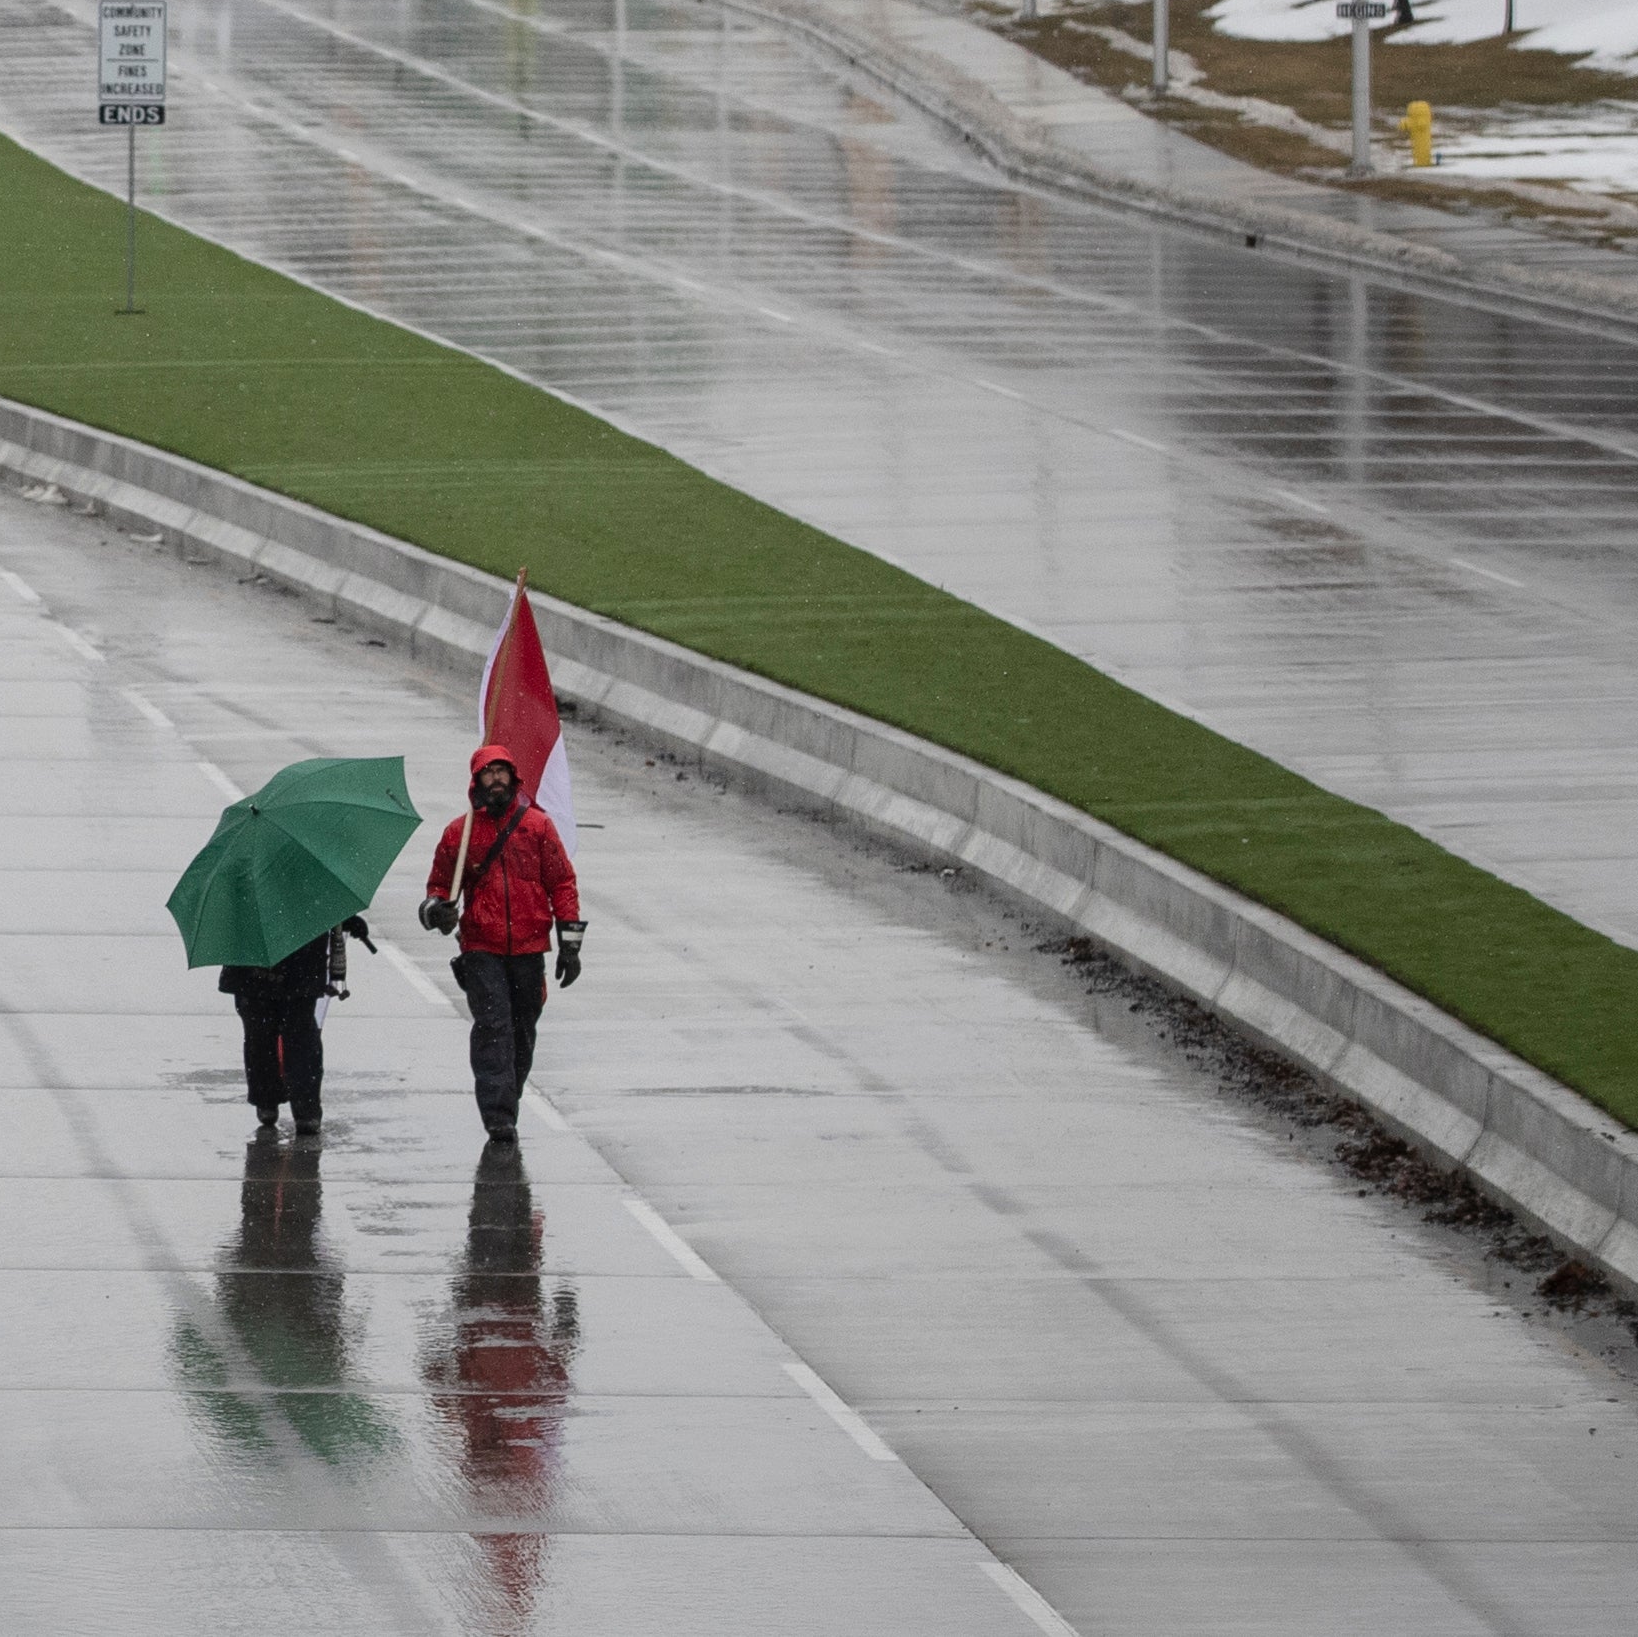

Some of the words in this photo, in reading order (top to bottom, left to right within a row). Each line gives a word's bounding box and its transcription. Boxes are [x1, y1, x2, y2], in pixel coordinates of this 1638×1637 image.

[102, 6, 163, 19] COMMUNITY
[114, 25, 152, 37] SAFETY
[118, 44, 146, 56] ZONE
[118, 65, 147, 77] FINES
[101, 83, 163, 95] INCREASED
[103, 106, 161, 123] ENDS
